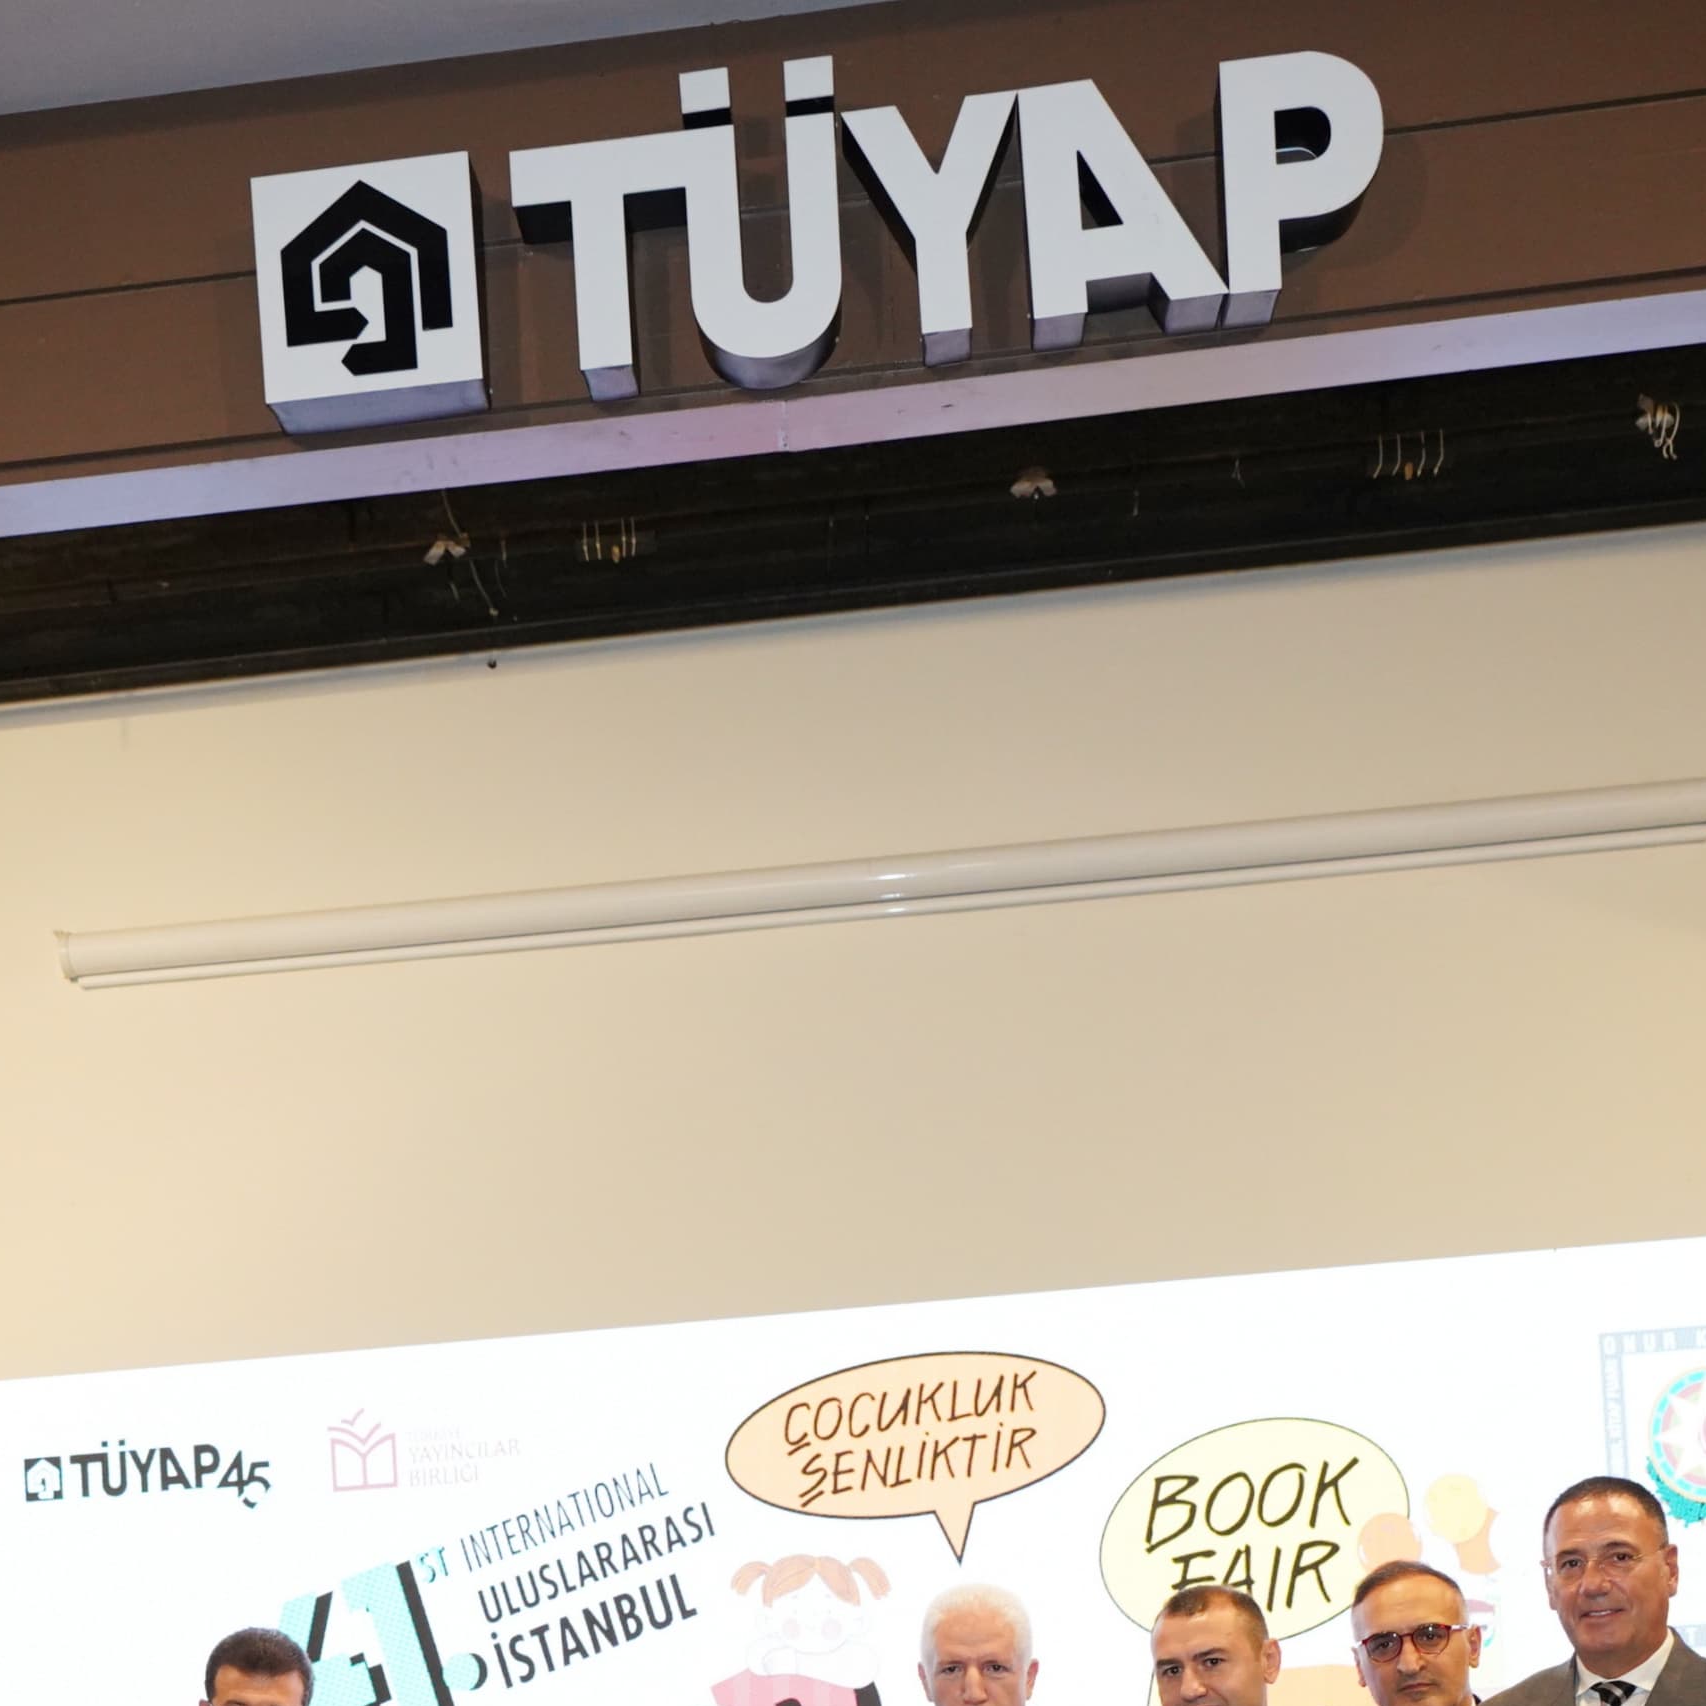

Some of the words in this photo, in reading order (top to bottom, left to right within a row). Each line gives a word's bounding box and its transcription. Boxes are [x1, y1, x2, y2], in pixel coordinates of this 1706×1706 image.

[508, 50, 1386, 378] TÜYAP
[784, 1369, 1038, 1456] ÇOCUKLUK
[798, 1418, 1038, 1507] ŞENLİKTİR
[459, 1461, 670, 1571] INTERNATIONAL
[1144, 1455, 1361, 1554] BOOK
[479, 1501, 716, 1625] ULUSLARARASI
[490, 1572, 698, 1690] İSTANBUL
